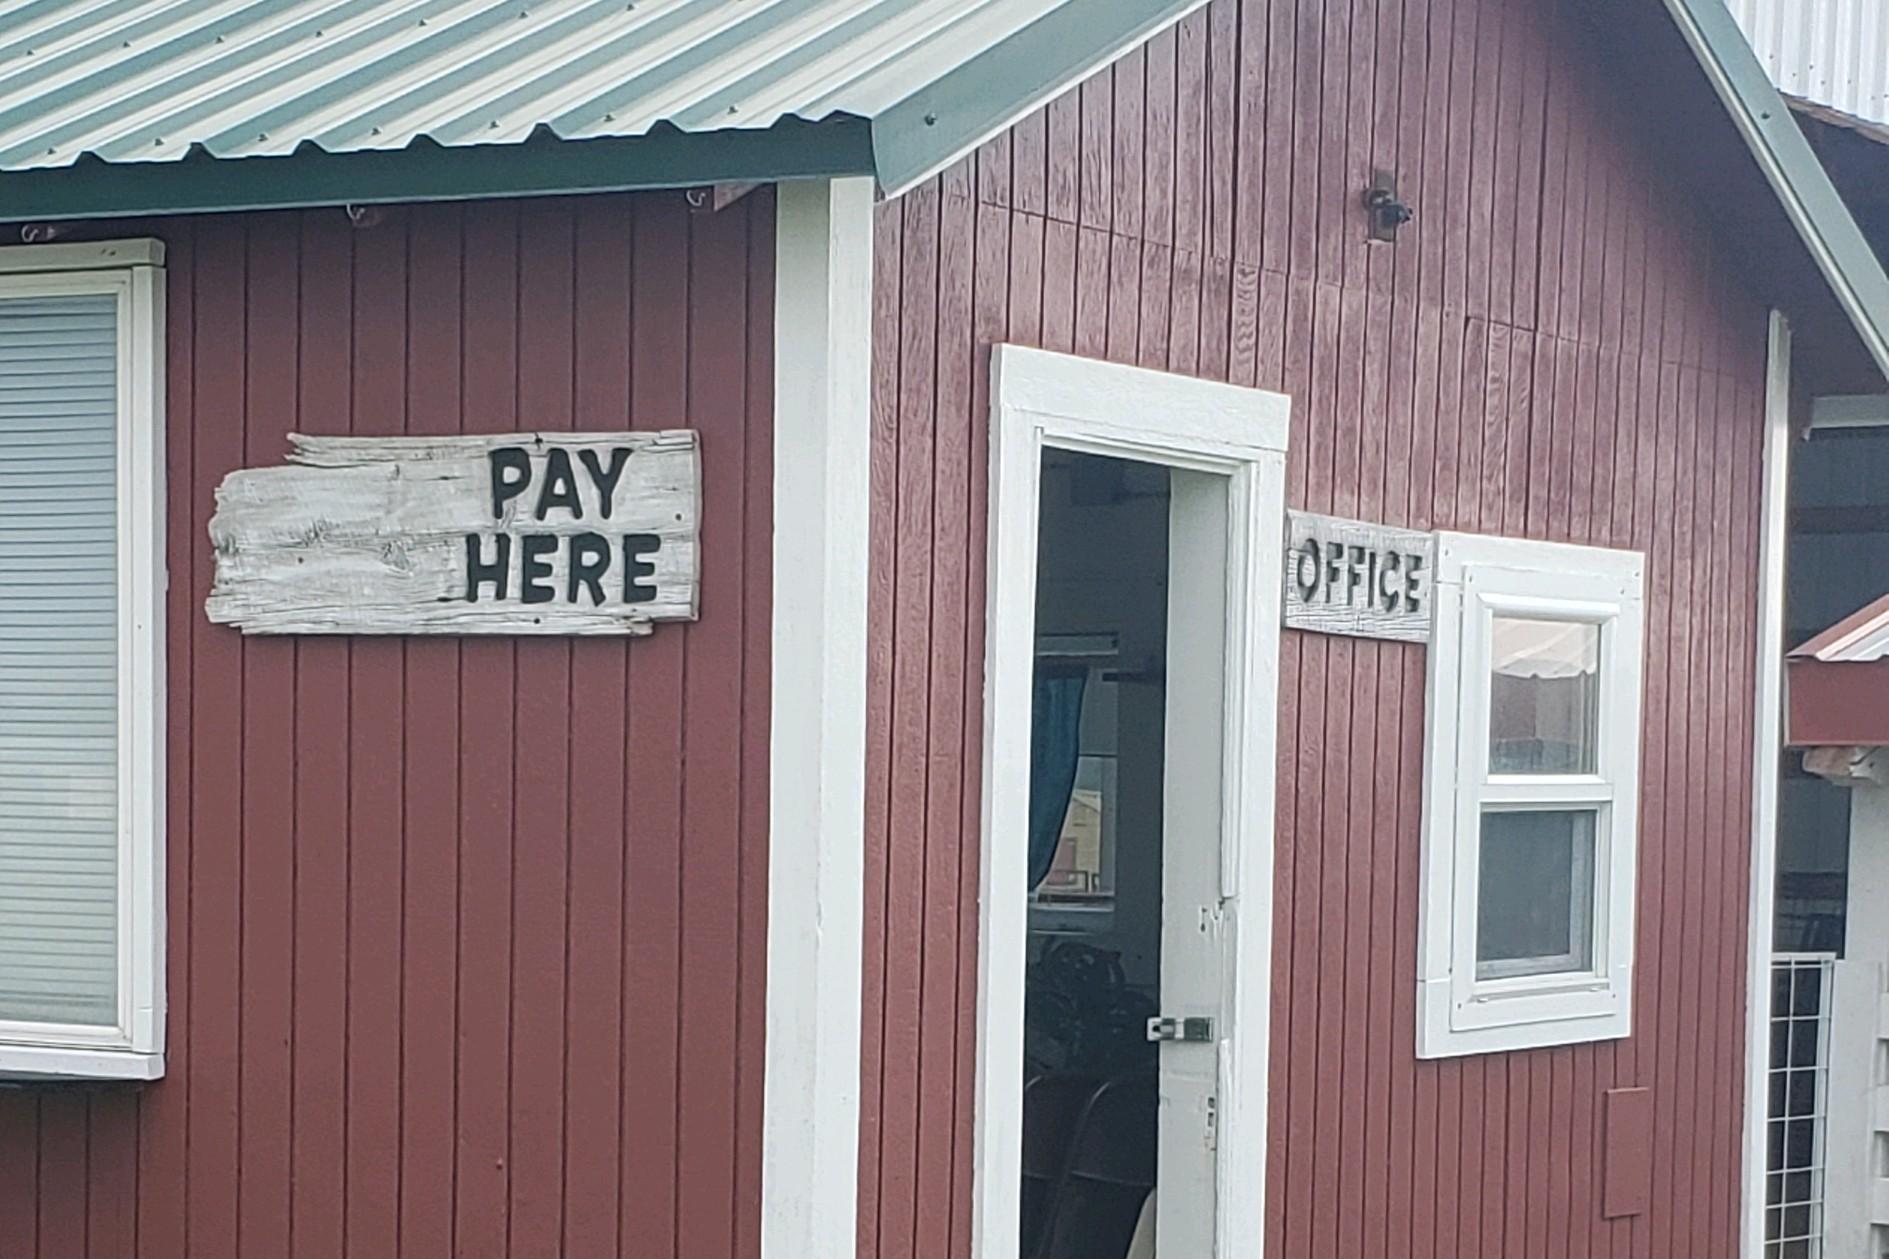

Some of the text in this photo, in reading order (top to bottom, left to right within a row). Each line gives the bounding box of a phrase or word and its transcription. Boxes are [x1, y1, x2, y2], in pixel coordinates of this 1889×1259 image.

[489, 447, 633, 520] PAY
[465, 534, 661, 606] HERE
[1297, 538, 1423, 613] OFFICE
